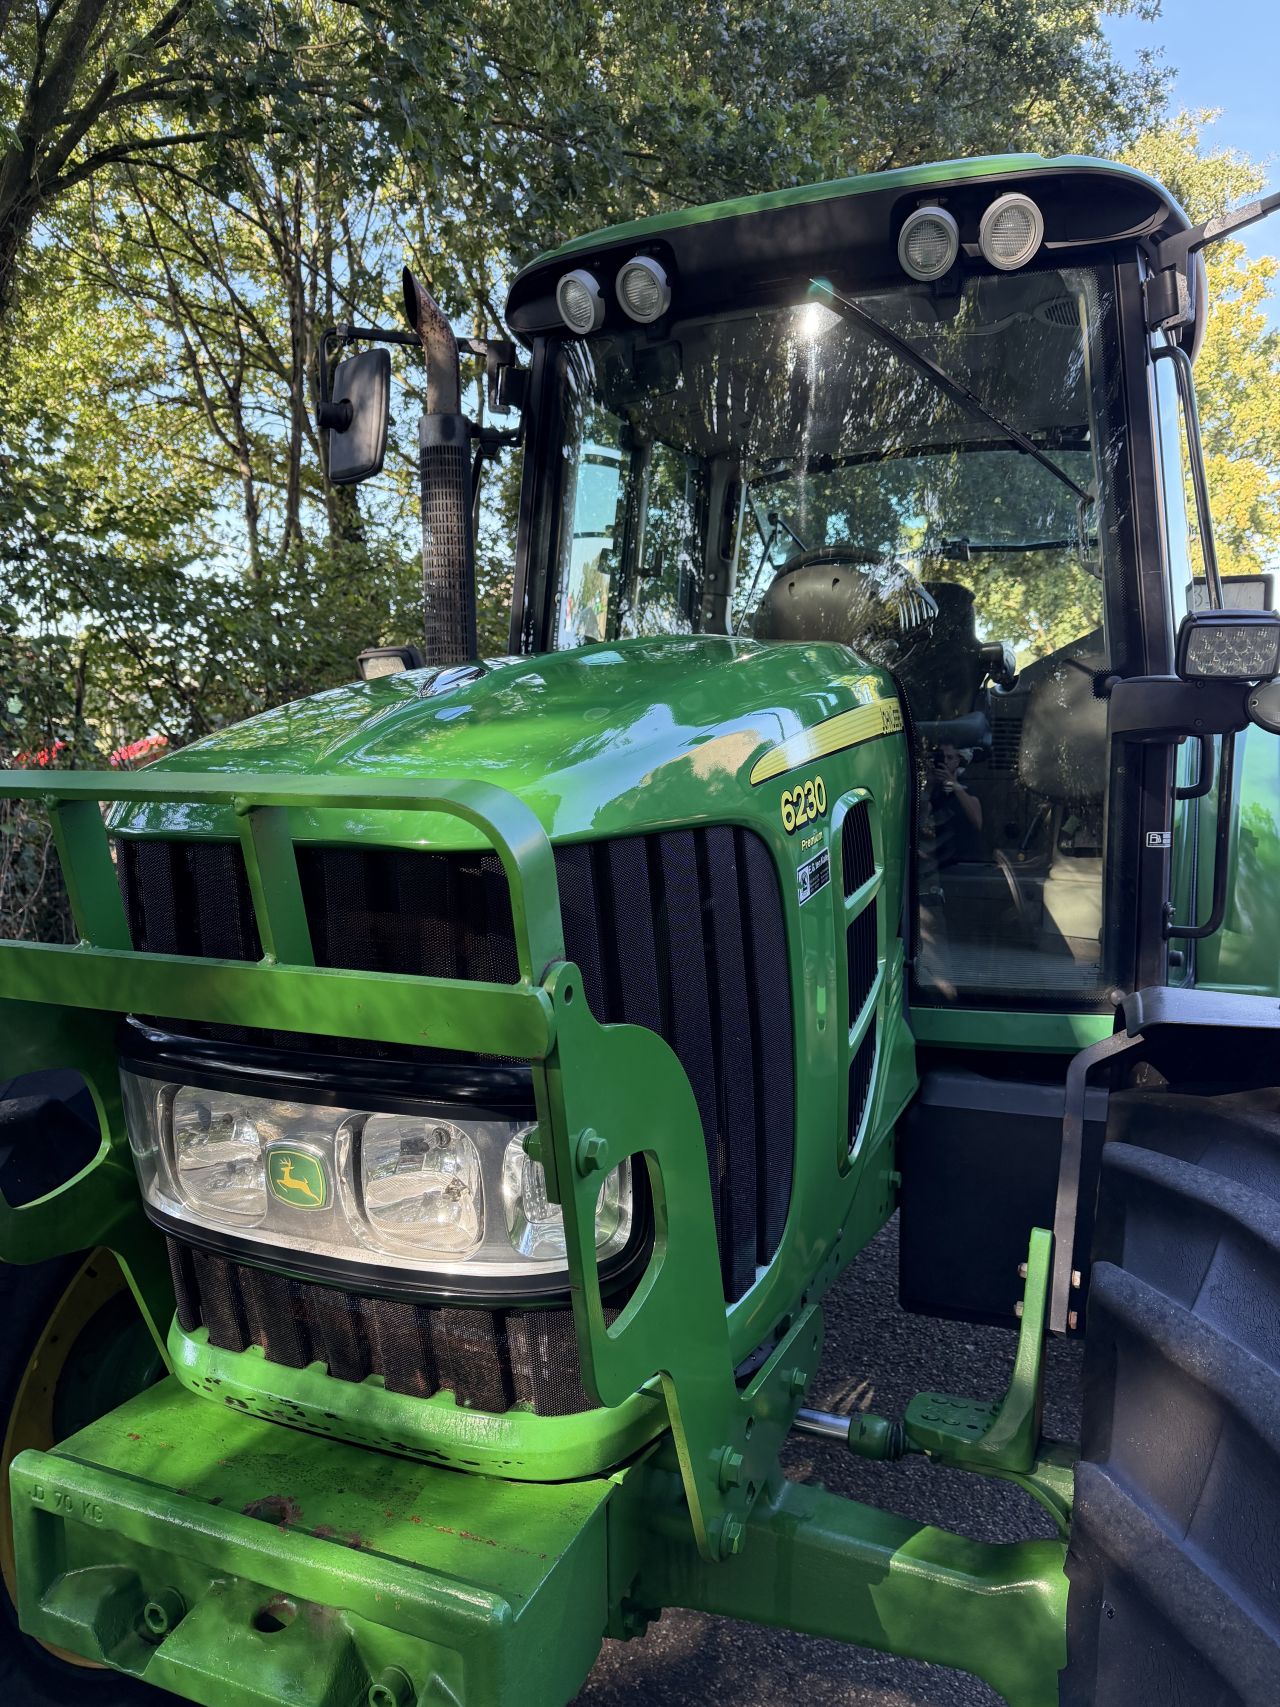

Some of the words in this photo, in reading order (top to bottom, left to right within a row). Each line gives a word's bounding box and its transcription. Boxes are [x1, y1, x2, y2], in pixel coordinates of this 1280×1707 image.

[781, 775, 828, 834] 6230
[54, 1490, 73, 1512] 70
[82, 1499, 104, 1522] KG
